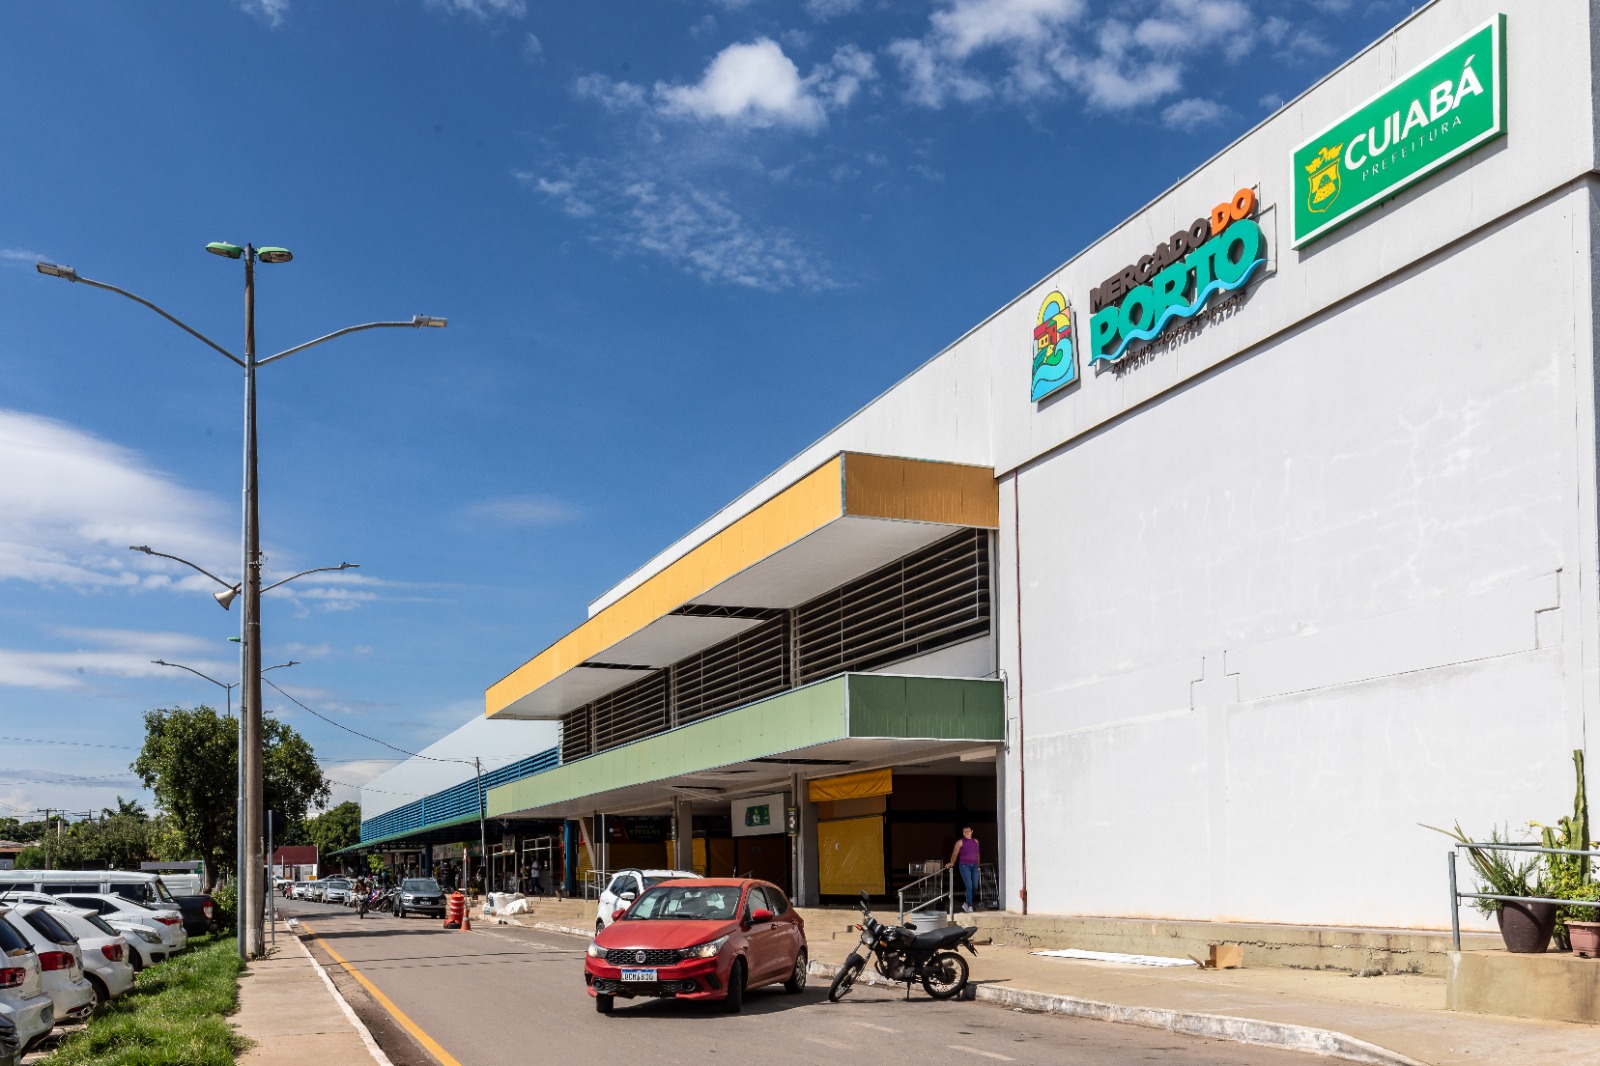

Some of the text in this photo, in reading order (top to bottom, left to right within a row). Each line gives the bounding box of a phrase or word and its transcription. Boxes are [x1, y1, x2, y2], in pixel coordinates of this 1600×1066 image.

[1344, 54, 1484, 170] CUIABÁ
[1362, 116, 1462, 181] PREFEITURA
[1090, 188, 1256, 314] MERCADO DO
[1090, 219, 1263, 362] PORTO
